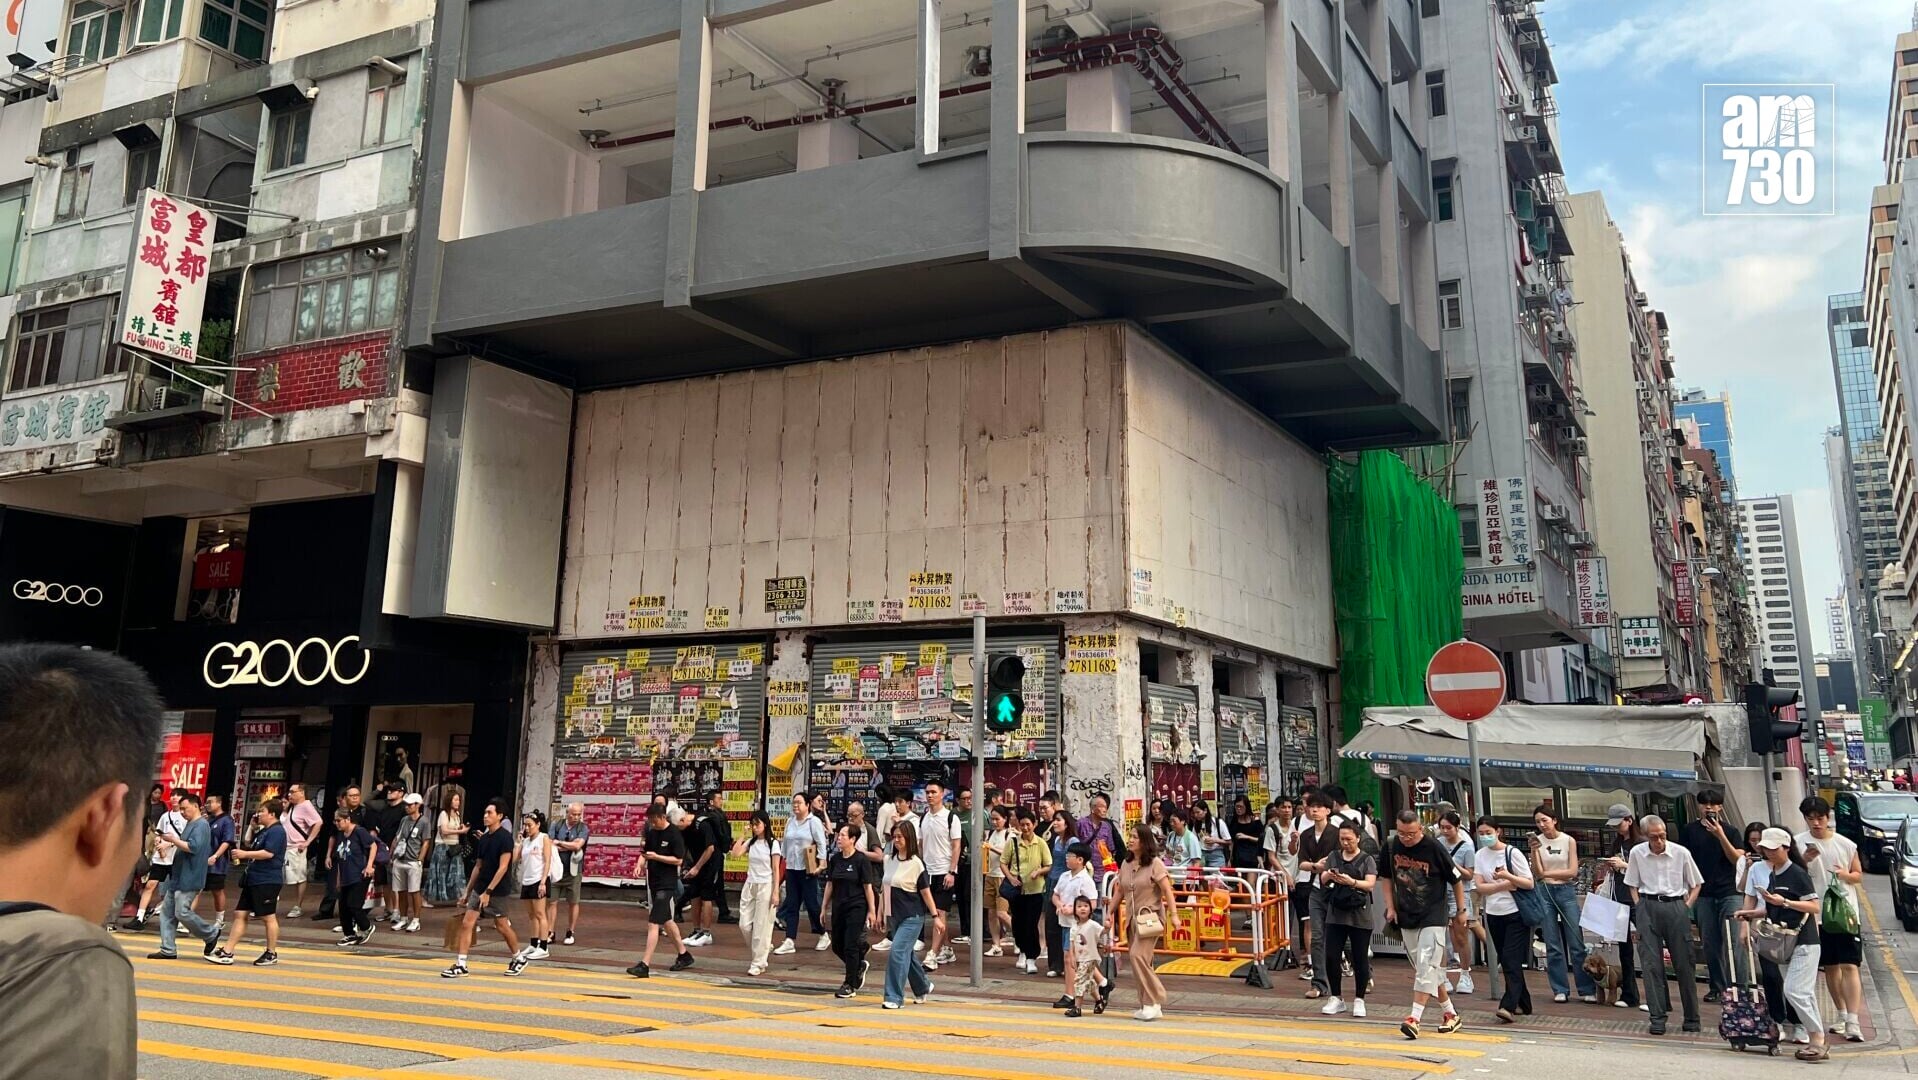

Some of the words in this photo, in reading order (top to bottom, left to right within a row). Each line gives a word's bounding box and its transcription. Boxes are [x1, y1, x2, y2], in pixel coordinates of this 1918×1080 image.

[140, 197, 178, 275] 富城
[174, 210, 208, 285] 皇都
[1483, 479, 1504, 555] 維珍尼亞賓館
[208, 560, 233, 579] SALE
[917, 572, 953, 585] 永昇物業
[1495, 571, 1535, 584] HOTEL
[13, 579, 104, 607] G2000
[1498, 592, 1537, 605] HOTEL
[636, 596, 666, 609] 永昇物業
[908, 596, 952, 608] 27811682
[628, 617, 665, 629] 27811682
[1077, 634, 1118, 649] 永昇物業
[203, 635, 371, 689] G2000
[1069, 659, 1118, 673] 27811682
[673, 667, 713, 681] 27811682
[776, 681, 809, 694] 永昇物業
[768, 703, 809, 717] 27811682
[169, 763, 207, 790] SALE
